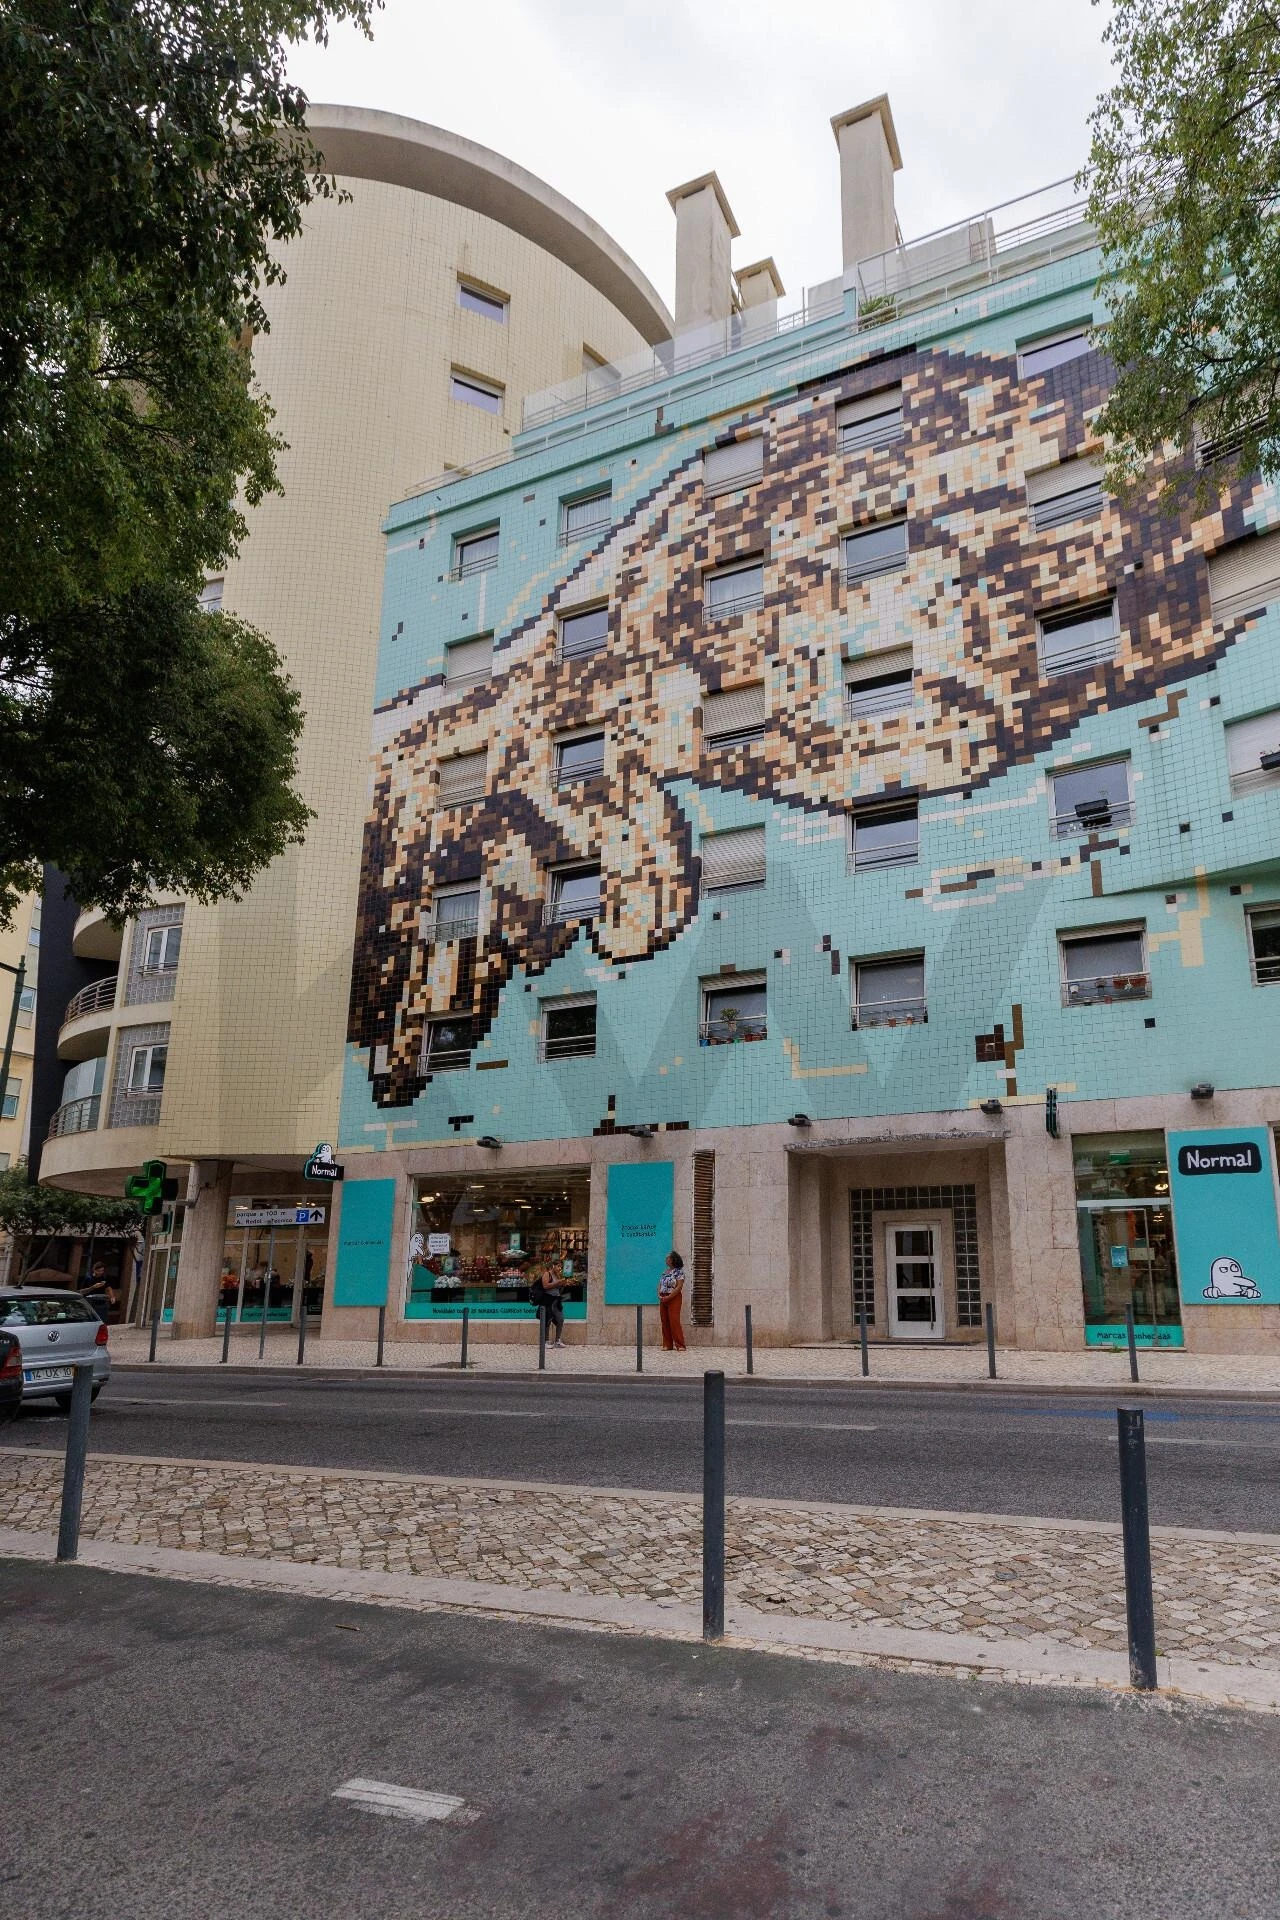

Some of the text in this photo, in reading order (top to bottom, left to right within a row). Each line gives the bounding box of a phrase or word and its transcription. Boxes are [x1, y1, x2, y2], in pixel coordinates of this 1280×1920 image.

[1186, 1149, 1252, 1169] Normal
[311, 1164, 338, 1177] Normal
[32, 1370, 41, 1379] 14
[45, 1368, 59, 1378] UX
